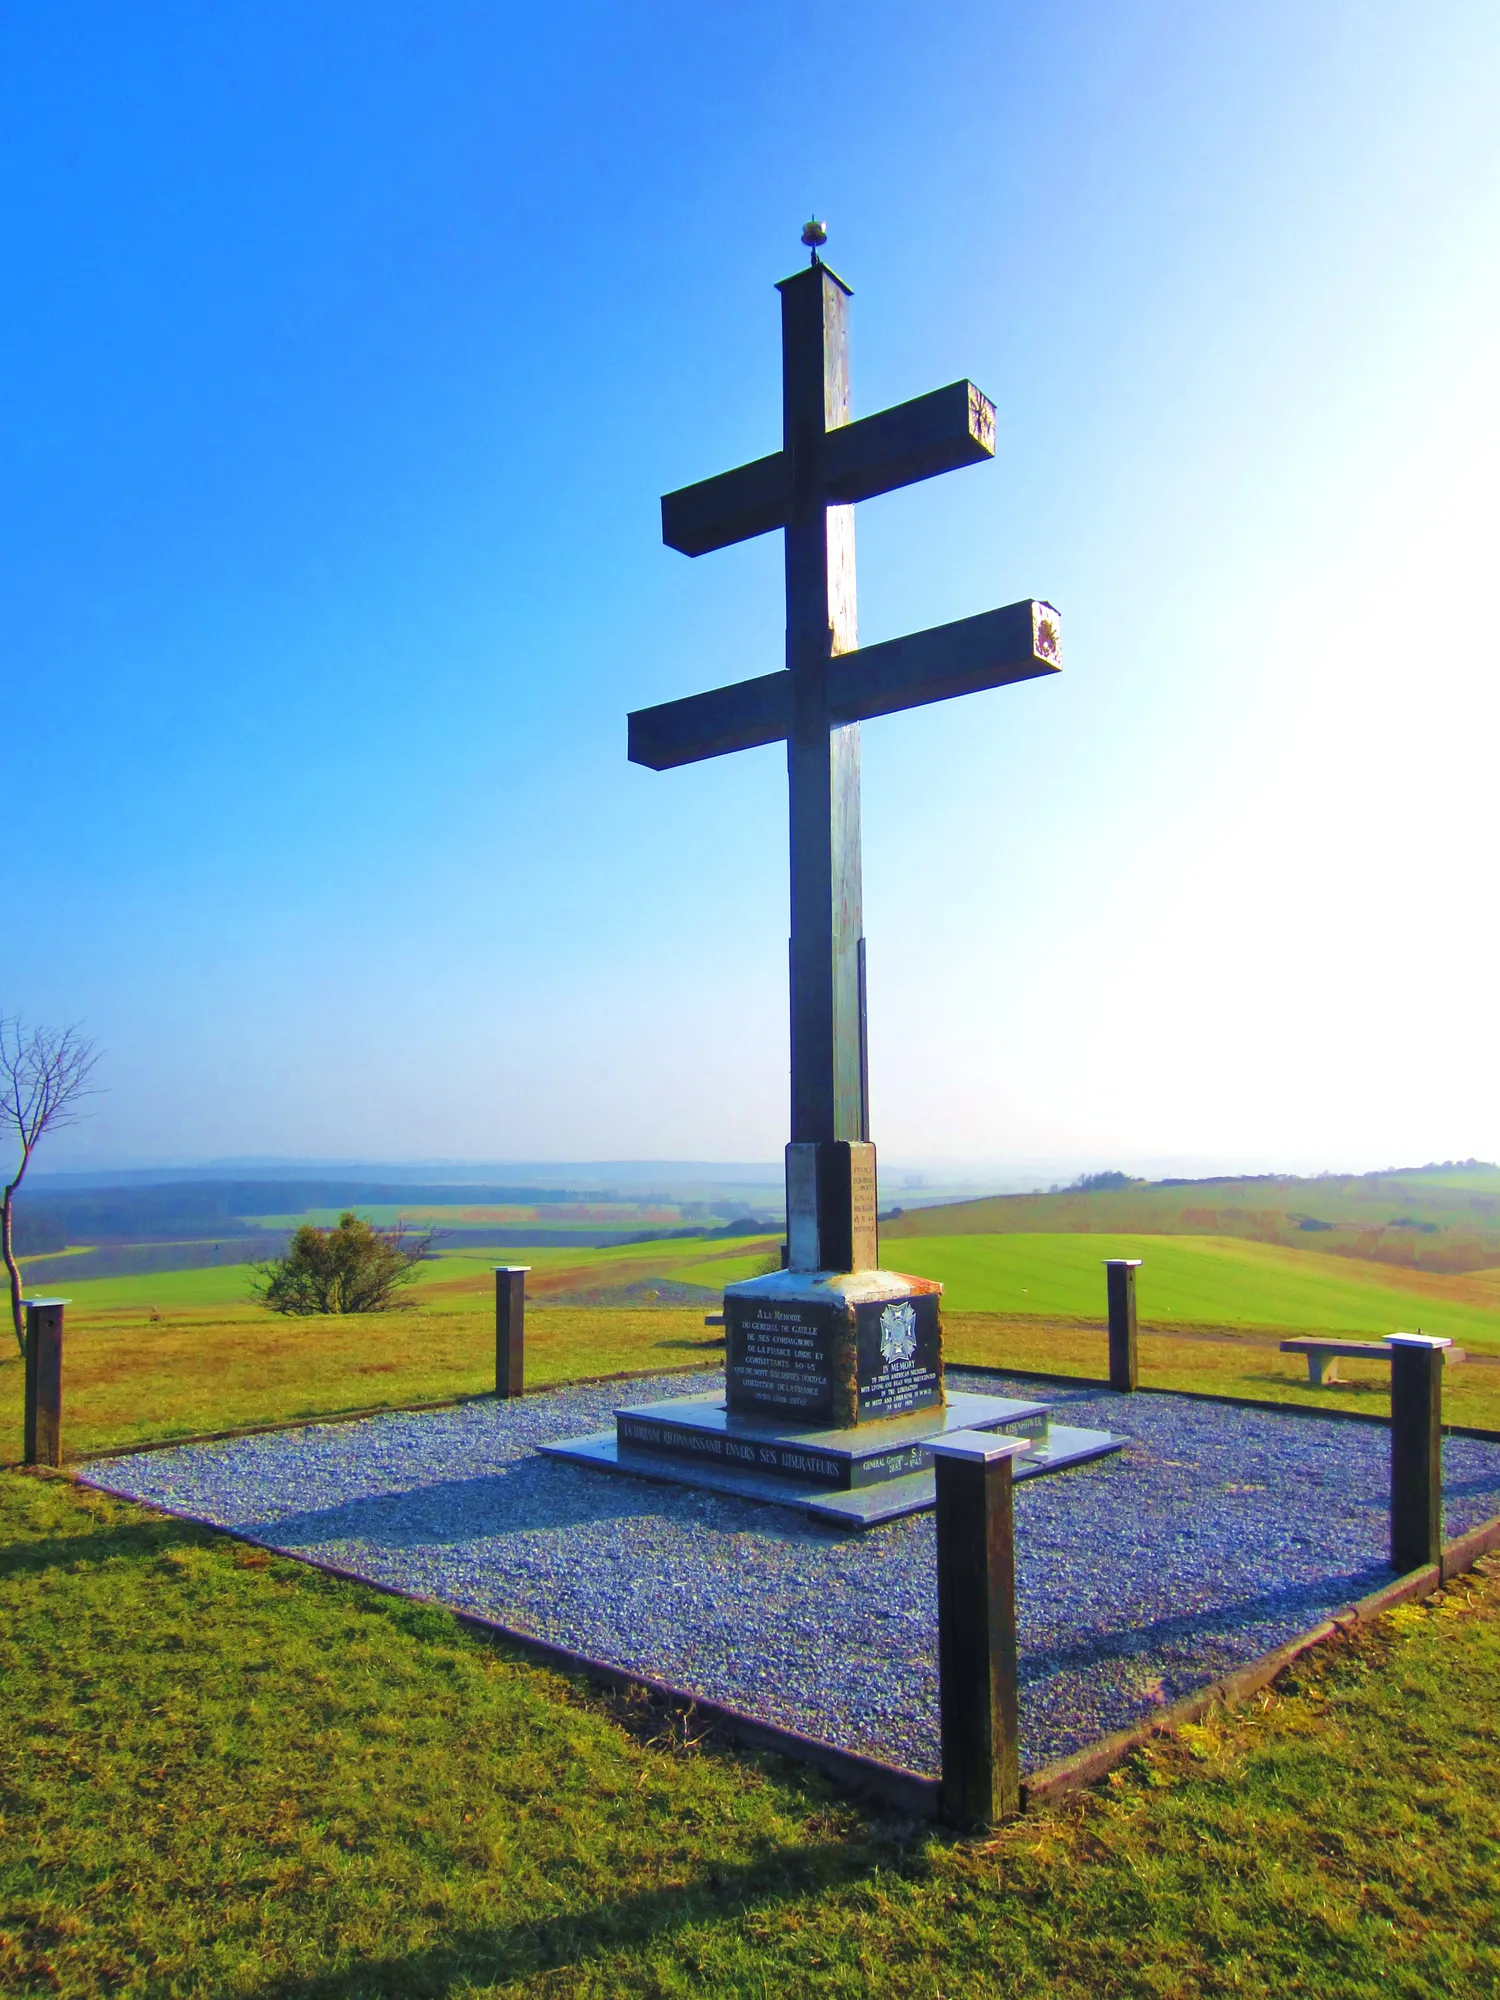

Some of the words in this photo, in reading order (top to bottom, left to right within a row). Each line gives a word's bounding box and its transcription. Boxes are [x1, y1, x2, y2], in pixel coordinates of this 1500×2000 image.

[757, 1309, 763, 1319] A
[764, 1311, 772, 1319] LA
[742, 1321, 751, 1329] DU
[792, 1326, 818, 1336] GAULLE
[747, 1333, 755, 1341] DE
[758, 1334, 770, 1342] SES
[773, 1336, 814, 1347] COMPAGNONS
[757, 1345, 766, 1353] LA
[767, 1347, 790, 1357] FRANCE
[795, 1350, 812, 1359] LIBRE
[815, 1352, 824, 1360] ET
[745, 1356, 790, 1368] COMBATTANTS
[882, 1364, 889, 1374] IN
[890, 1360, 915, 1372] MEMORY
[735, 1366, 744, 1374] QUI
[753, 1368, 768, 1376] SONT
[801, 1375, 817, 1384] POUR
[818, 1377, 827, 1385] LA
[891, 1371, 909, 1380] AMERICAN
[777, 1383, 785, 1391] DE
[786, 1384, 794, 1392] LA
[871, 1383, 884, 1391] LIVING
[897, 1384, 918, 1393] LIBERATION
[872, 1398, 882, 1406] METZ
[884, 1396, 892, 1404] AND
[893, 1392, 913, 1402] LORRAINE
[1006, 1416, 1043, 1434] EISENHOWER
[624, 1423, 633, 1437] LA
[634, 1426, 660, 1442] LORRAINE
[664, 1430, 722, 1454] RECONNAISSANTE
[726, 1442, 755, 1461] ENVERS
[760, 1448, 777, 1464] SES
[782, 1453, 840, 1477] LIBERATEURS
[863, 1458, 885, 1471] GENERAL
